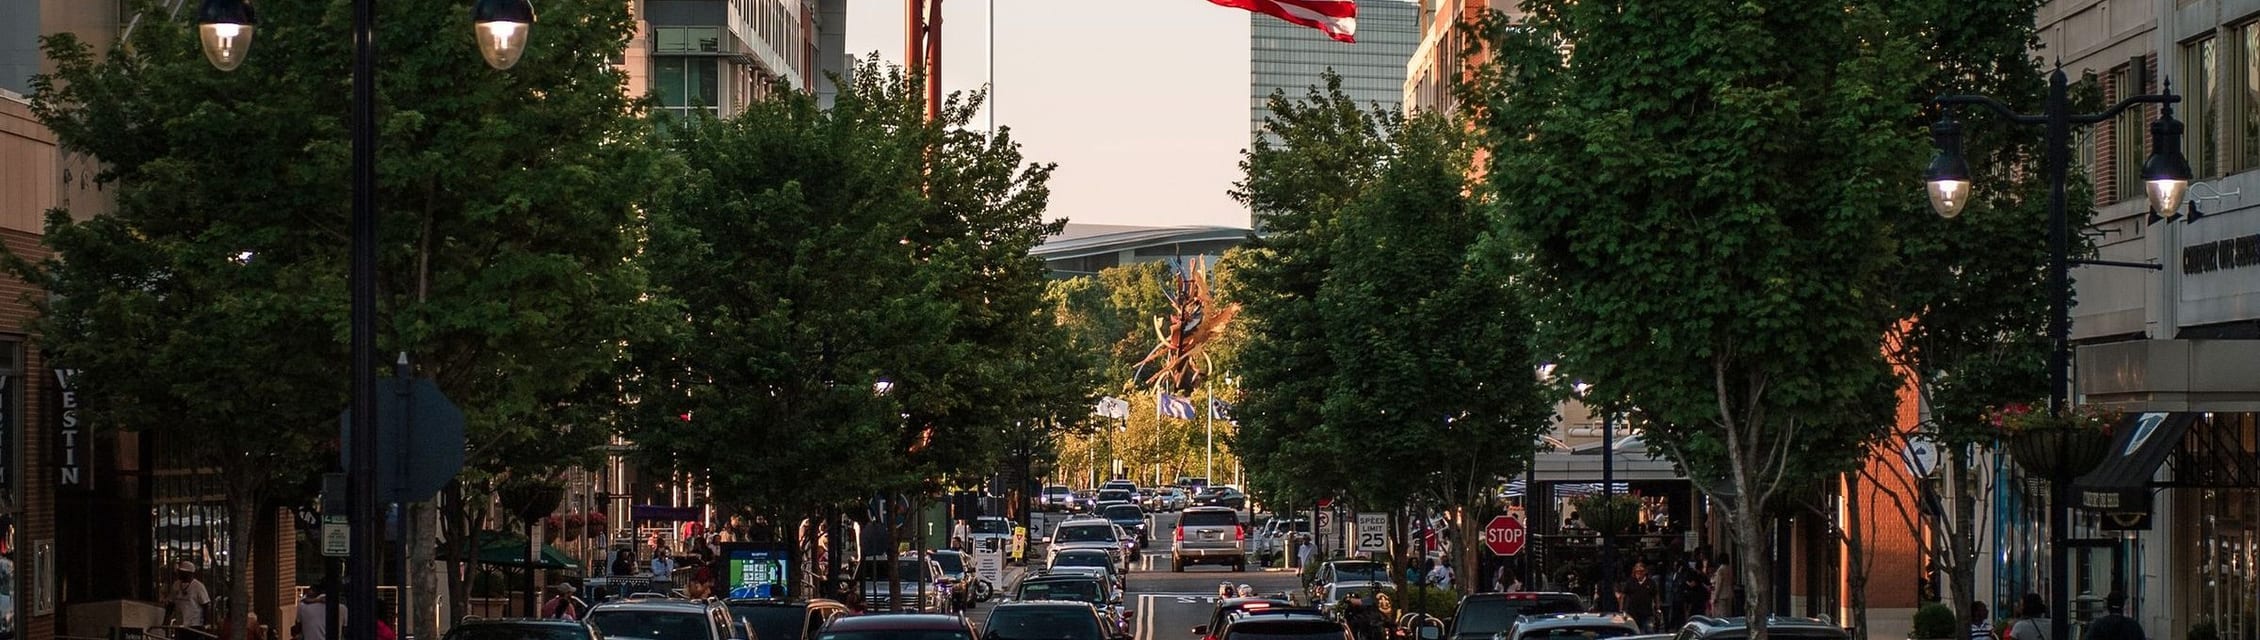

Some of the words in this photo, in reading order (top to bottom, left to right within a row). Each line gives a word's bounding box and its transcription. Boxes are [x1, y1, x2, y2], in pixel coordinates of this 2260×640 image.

[54, 368, 84, 485] WESTIN
[1360, 517, 1386, 525] SPEED
[1361, 533, 1385, 547] 25
[1488, 528, 1523, 543] STOP
